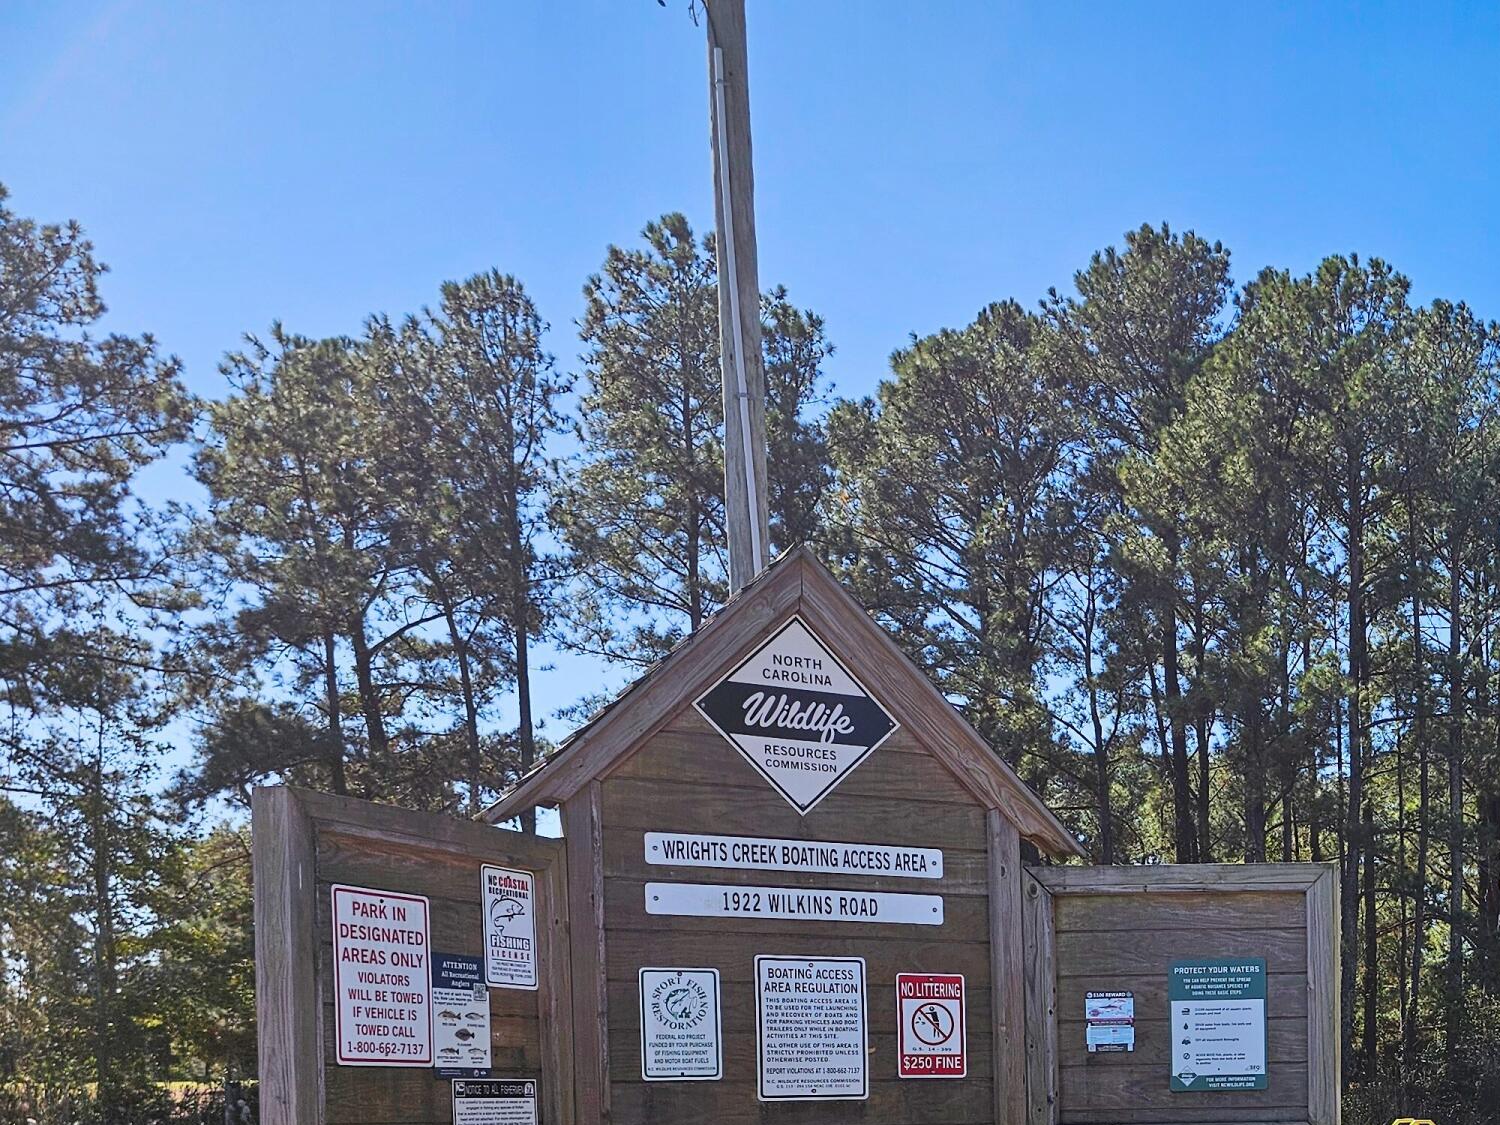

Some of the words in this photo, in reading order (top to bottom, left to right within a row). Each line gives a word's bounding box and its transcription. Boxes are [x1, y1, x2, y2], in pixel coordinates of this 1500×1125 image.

[773, 654, 822, 670] NORTH
[763, 668, 832, 686] CAROLINA
[742, 692, 854, 743] Wildlife
[764, 745, 836, 760] RESOURCES
[766, 759, 837, 773] COMMISSION
[662, 840, 727, 861] WRIGHTS
[732, 843, 777, 864] CREEK
[782, 847, 838, 868] BOATING
[843, 850, 890, 870] ACCESS
[895, 853, 926, 872] AREA
[488, 875, 497, 886] NC
[499, 876, 529, 891] COASTAL
[488, 887, 528, 899] RECREATIONAL
[352, 901, 388, 919] PARK
[393, 907, 406, 922] IN
[722, 892, 761, 912] 1922
[768, 893, 832, 914] WILKINS
[840, 897, 878, 916] ROAD
[341, 924, 423, 945] DESIGNATED
[492, 935, 530, 950] FISHING
[342, 947, 385, 965] AREAS
[391, 952, 423, 968] ONLY
[492, 950, 530, 960] LICENSE
[442, 961, 477, 970] ATTENTION
[358, 972, 410, 986] VIOLATORS
[768, 968, 812, 979] BOATING
[816, 969, 853, 980] ACCESS
[652, 977, 681, 1000] SPORT
[686, 979, 707, 999] FISH
[764, 982, 791, 992] AREA
[795, 983, 857, 993] REGULATION
[901, 983, 913, 996] NO
[917, 983, 960, 997] LITTERING
[348, 988, 371, 1000] WILL
[375, 991, 387, 1002] BE
[391, 992, 423, 1004] TOWED
[353, 1007, 362, 1018] IF
[365, 1008, 404, 1020] VEHICLE
[408, 1010, 417, 1020] IS
[651, 1001, 708, 1030] RESTORATION
[355, 1024, 389, 1036] TOWED
[392, 1026, 415, 1038] CALL
[348, 1041, 423, 1055] 1-800-662-7137
[904, 1056, 932, 1070] $250
[936, 1057, 961, 1068] FINE
